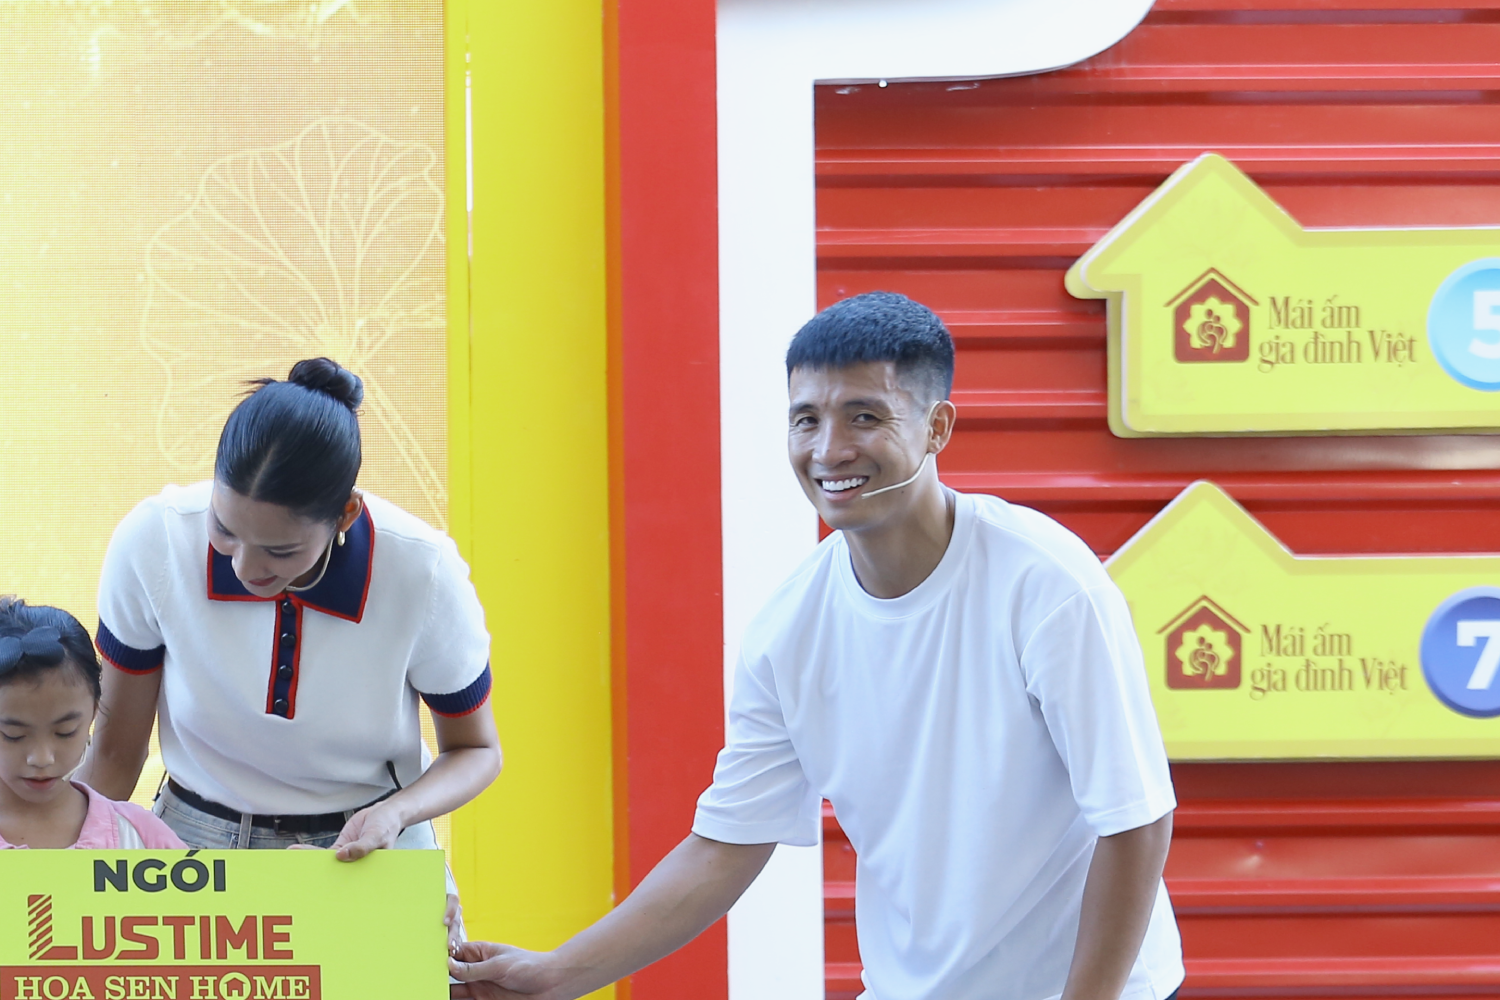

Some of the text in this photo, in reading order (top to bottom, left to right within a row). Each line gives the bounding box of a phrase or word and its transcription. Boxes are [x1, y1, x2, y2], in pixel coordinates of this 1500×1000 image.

[1268, 294, 1361, 330] Mái ấm
[1468, 289, 1500, 360] 5
[1257, 329, 1418, 374] gia đình Việt
[1259, 622, 1352, 657] Mái ấm
[1456, 620, 1500, 690] 7
[1249, 657, 1409, 701] gia đình Việt
[93, 850, 226, 893] NGÓI
[27, 894, 294, 961] LUSTIME
[14, 976, 95, 1000] HOA
[104, 975, 180, 1000] SEN
